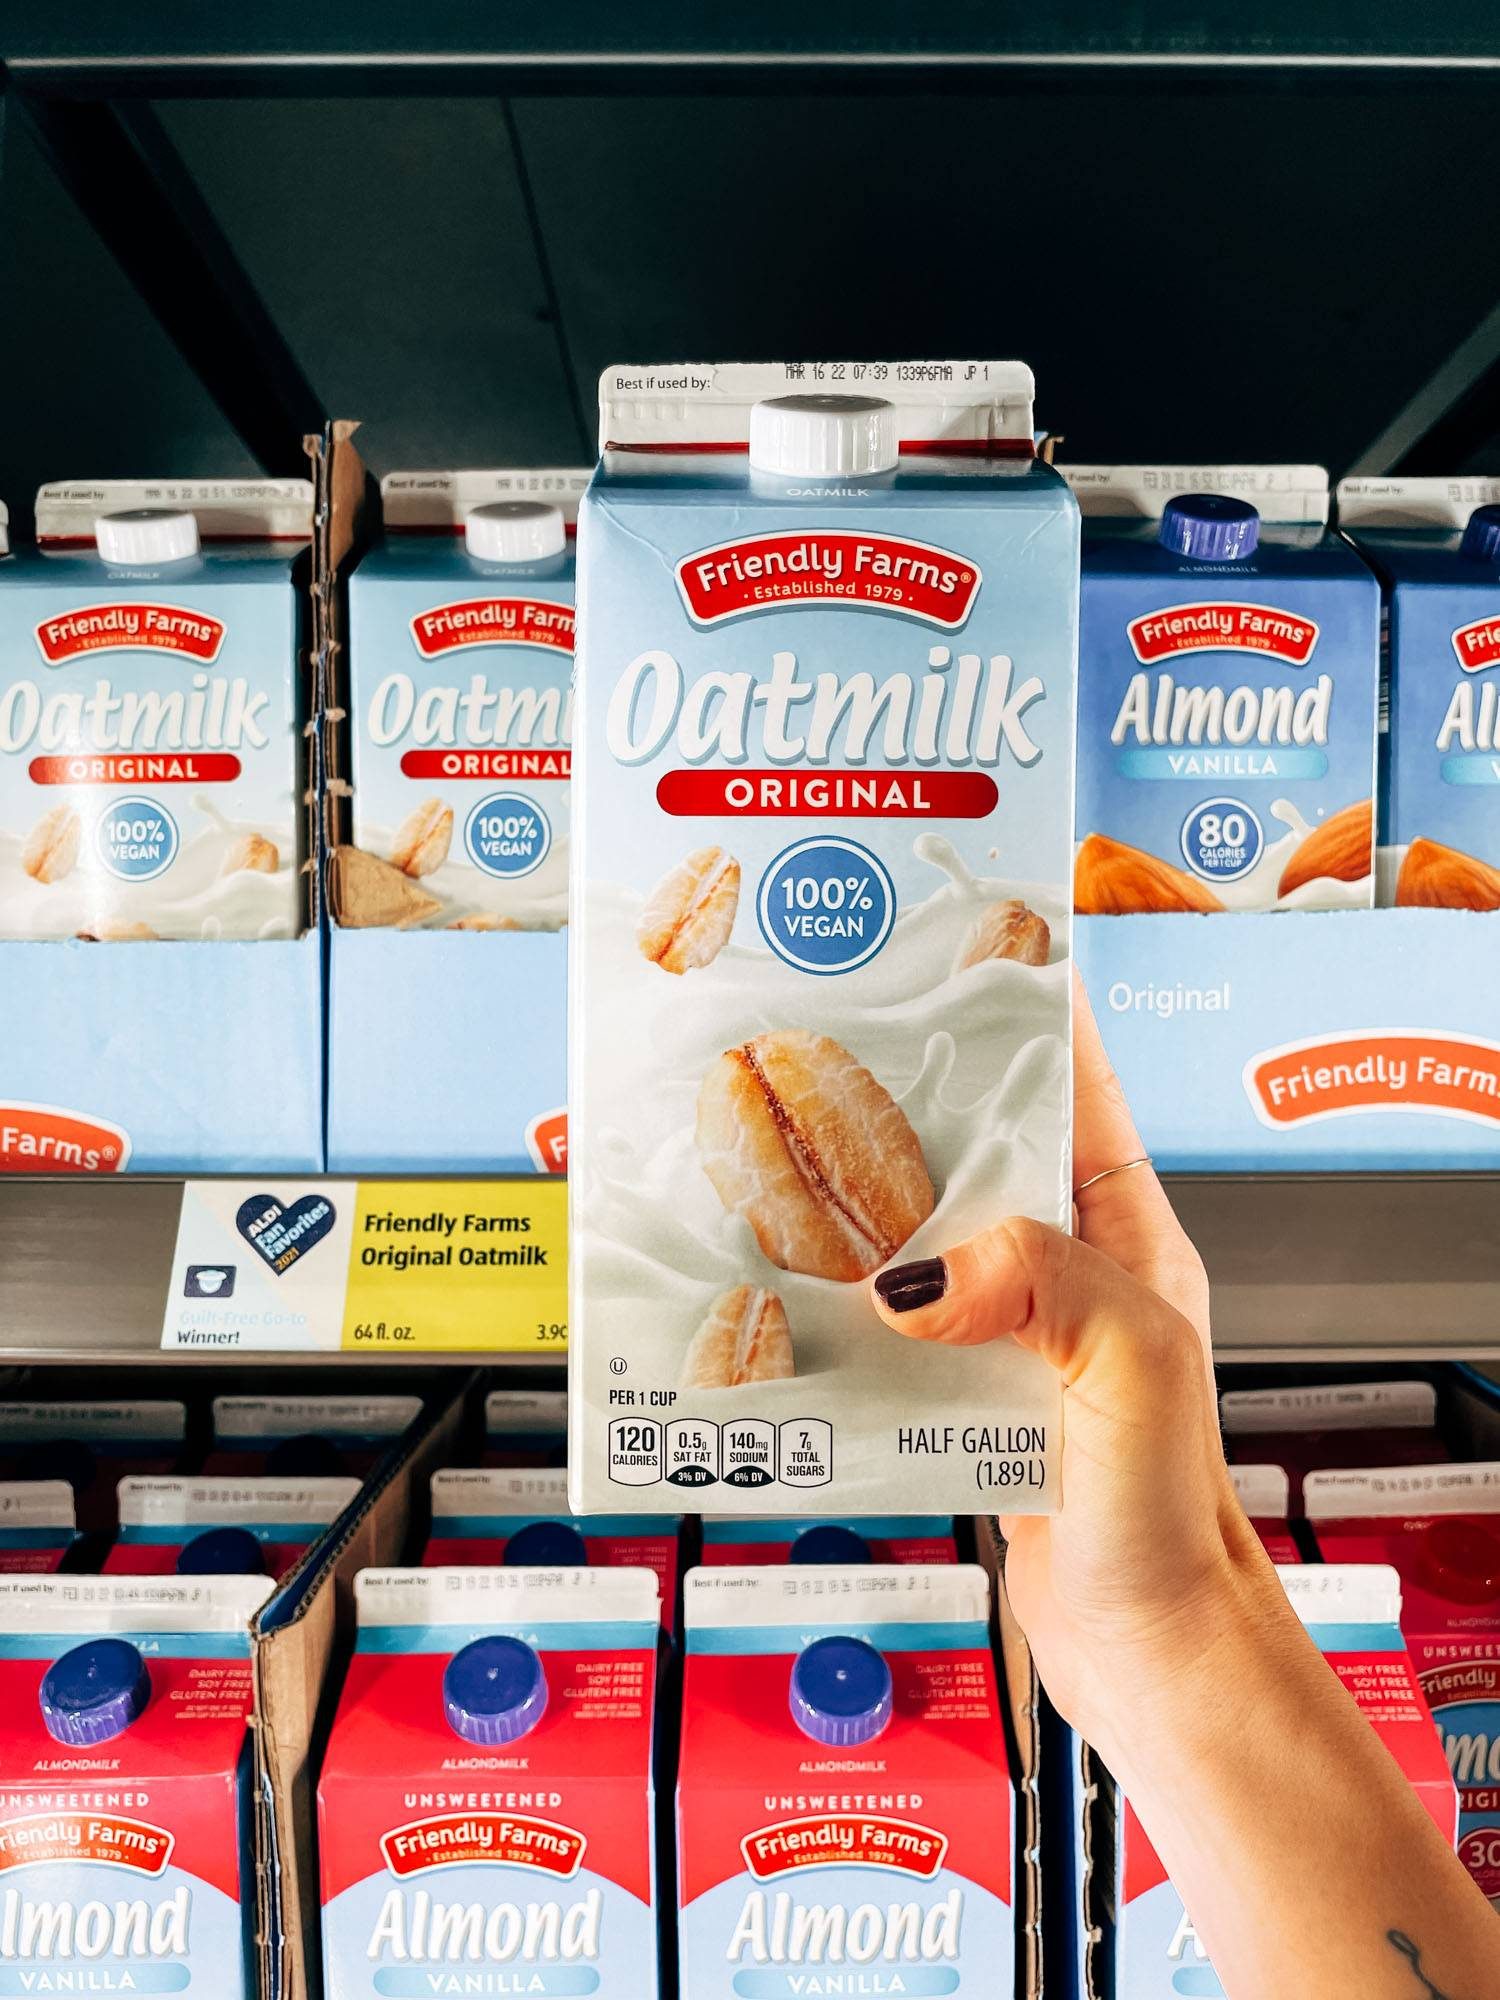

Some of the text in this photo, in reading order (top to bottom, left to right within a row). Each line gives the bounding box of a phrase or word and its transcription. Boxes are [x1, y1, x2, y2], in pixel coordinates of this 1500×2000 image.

[786, 364, 805, 380] MAR
[813, 364, 825, 380] 16
[831, 364, 846, 380] 22
[853, 364, 888, 381] 07:39
[964, 365, 977, 381] JP
[984, 365, 989, 381] 1
[616, 377, 711, 392] Best if used by:
[787, 487, 870, 498] OATMILK
[697, 543, 843, 592] Friendly
[755, 581, 904, 602] Established 1979
[47, 610, 139, 645] Friendly
[422, 605, 517, 637] Friendly
[1140, 610, 1233, 644] Friendly
[0, 673, 269, 754] Oatmilk
[606, 646, 1046, 767] Oatmilk
[1110, 672, 1333, 748] Almond
[69, 758, 200, 779] ORIGINAL
[1168, 755, 1278, 776] VANILLA
[725, 778, 931, 810] ORIGINAL
[107, 820, 165, 844] 100%
[478, 815, 537, 840] 100%
[1199, 813, 1246, 848] 80
[110, 844, 161, 860] VEGAN
[481, 841, 533, 858] VEGAN
[1199, 847, 1246, 859] CALORIES
[781, 876, 875, 912] 100%
[784, 915, 865, 938] VEGAN
[1108, 982, 1231, 1018] Original
[1268, 1055, 1407, 1106] Friendly
[247, 1204, 283, 1238] ALDI
[263, 1201, 330, 1260] Favorites
[364, 1212, 531, 1237] Friendly Farms
[255, 1222, 287, 1250] Fan
[274, 1247, 300, 1271] 2021
[361, 1245, 548, 1271] Original Oatmilk
[180, 1310, 307, 1327] Guilt-Free Go-to
[177, 1329, 241, 1344] Winner!
[354, 1322, 416, 1340] 64 fl. oz.
[609, 1390, 677, 1406] PER 1 CUP
[616, 1426, 655, 1452] 120
[679, 1432, 707, 1451] 0.5g
[729, 1432, 769, 1451] 140mg
[799, 1432, 812, 1451] 7g
[899, 1427, 1045, 1453] HALF GALLON
[612, 1455, 658, 1466] CALORIES
[674, 1452, 712, 1463] SAT FAT
[729, 1452, 768, 1463] SODIUM
[791, 1452, 820, 1463] TOTAL
[678, 1472, 706, 1482] 3% DV
[734, 1473, 763, 1483] 6% DV
[786, 1465, 825, 1477] SUGARS
[614, 1663, 644, 1673] FREE
[953, 1663, 984, 1673] FREE
[1375, 1664, 1406, 1675] FREE
[197, 1680, 220, 1688] SOY
[587, 1675, 643, 1685] SOY FREE
[956, 1675, 986, 1685] FREE
[1353, 1676, 1411, 1687] SOY FREE
[170, 1690, 249, 1700] GLUTEN FREE
[563, 1687, 643, 1698] GLUTEN FREE
[957, 1687, 988, 1698] FREE
[1384, 1689, 1416, 1700] FREE
[33, 1759, 121, 1771] ALMONDMILK
[441, 1758, 530, 1770] ALMONDMILK
[799, 1760, 887, 1772] ALMONDMILK
[404, 1792, 562, 1808] UNSWEETENED
[764, 1794, 924, 1811] UNSWEETENED
[394, 1822, 493, 1857] Friendly
[755, 1824, 855, 1859] Friendly
[96, 1848, 122, 1860] 1979
[366, 1887, 604, 1963] Almond
[726, 1888, 965, 1965] Almond
[18, 1970, 137, 1991] VANILLA
[426, 1973, 545, 1993] VANILLA
[787, 1974, 906, 1994] VANILLA
